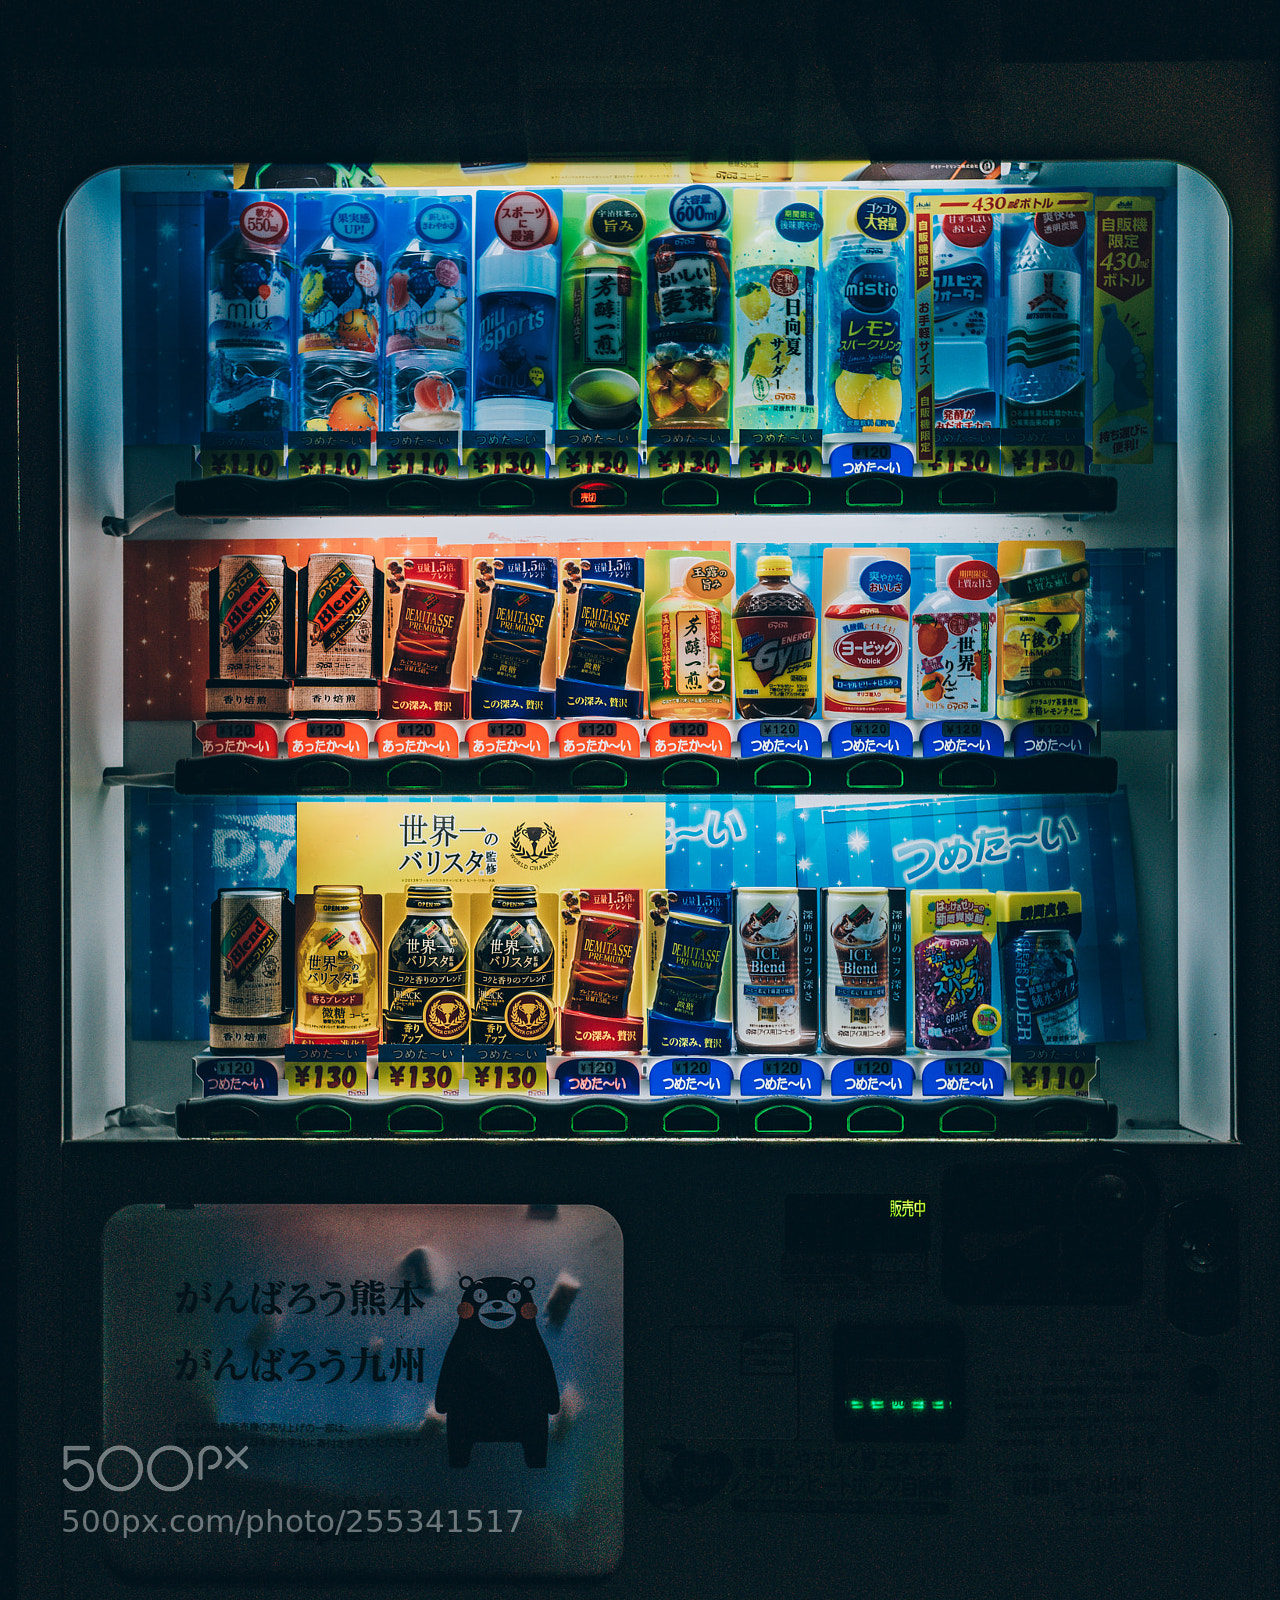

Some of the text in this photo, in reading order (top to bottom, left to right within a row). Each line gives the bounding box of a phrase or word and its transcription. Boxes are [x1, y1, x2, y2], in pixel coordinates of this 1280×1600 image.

[680, 194, 711, 205] 大容量
[501, 206, 545, 219] スポーツ
[597, 209, 638, 218] 宇治抹茶の
[676, 205, 717, 222] 600ml
[865, 203, 898, 214] ゴクゴク
[338, 212, 371, 224] 果実感
[428, 213, 449, 221] 新しい
[518, 219, 528, 228] に
[864, 215, 899, 231] 大容量
[247, 217, 279, 232] 550ml
[344, 223, 366, 235] UP!
[603, 219, 634, 233] 旨み
[952, 225, 987, 233] おいしさ
[1043, 220, 1079, 235] 透明炭酸
[1102, 217, 1149, 232] 自販機
[510, 229, 535, 242] 最適
[674, 237, 696, 246] DyDo
[1108, 234, 1140, 249] 限定
[705, 239, 717, 249] 600
[918, 220, 929, 278] 自販機限定
[659, 267, 710, 288] おいしい
[1103, 273, 1145, 288] ボトル
[845, 281, 899, 297] mistio
[661, 284, 712, 318] 麦茶
[590, 274, 618, 356] 芳醇一煎
[785, 297, 802, 357] 日向夏
[848, 321, 896, 337] レモン
[838, 339, 903, 352] スパークリング
[918, 302, 930, 375] お手軽サイズ
[770, 337, 786, 390] サイダー
[774, 392, 797, 402] DyDo
[942, 409, 976, 421] 発酵が
[919, 396, 931, 454] 自販機限定
[1099, 424, 1149, 443] 持ち運びに
[580, 492, 597, 503] 売切
[430, 572, 453, 580] ブレンド
[522, 571, 546, 579] ブレンド
[691, 565, 728, 579] 玉露の
[868, 571, 903, 582] 爽やかな
[227, 566, 254, 601] DyDo
[318, 566, 346, 600] DyDo
[701, 579, 722, 591] 旨み
[869, 582, 903, 593] おいしさ
[957, 579, 993, 588] 上質な甘さ
[226, 578, 270, 631] Blend
[316, 577, 362, 629] Blend
[405, 607, 455, 629] DEMITASSE
[495, 607, 546, 628] DEMITASSE
[580, 606, 631, 627] DEMITASSE
[408, 621, 444, 635] PREMIUM
[500, 620, 536, 634] PREMIUM
[584, 619, 620, 633] PREMIUM
[767, 621, 789, 630] DyDo
[781, 630, 812, 646] ENERGY
[683, 614, 703, 690] 芳醇一煎
[841, 641, 896, 656] ヨービック
[745, 638, 813, 677] Gym
[857, 657, 881, 665] Yobick
[957, 636, 976, 681] 世界一
[941, 658, 958, 700] りんご
[223, 695, 267, 705] 香り焙煎
[312, 694, 356, 704] 香り焙煎
[391, 700, 452, 712] この深み、贅沢
[482, 699, 544, 710] この深み、贅沢
[567, 696, 628, 708] この深み、贅沢
[946, 701, 970, 711] DyDo
[1027, 705, 1082, 716] 本格レモンティー
[219, 723, 251, 737] ¥120
[309, 723, 343, 737] ¥120
[400, 723, 433, 737] ¥120
[490, 723, 523, 737] ¥120
[581, 723, 614, 737] ¥120
[672, 723, 706, 737] ¥120
[764, 723, 795, 734] ¥120
[854, 723, 887, 734] ¥120
[946, 723, 979, 734] ¥120
[399, 814, 499, 848] 世界一の
[510, 851, 560, 872] WORLD CHAMPION
[608, 903, 632, 911] ブレンド
[935, 899, 986, 913] はじけるゼリーの
[935, 911, 986, 926] 新感覚炭酸
[229, 918, 266, 967] Blend
[406, 939, 455, 955] 世界一の
[490, 939, 539, 955] 世界一の
[584, 938, 633, 958] DEMITASSE
[949, 938, 970, 947] DyDo
[588, 952, 624, 964] PREMIUM
[671, 942, 721, 963] DEMITASSE
[756, 947, 780, 960] ICE
[803, 909, 814, 1002] 深煎りのコク深さ
[849, 949, 873, 961] ICE
[891, 909, 903, 1002] 深煎りのコク深さ
[307, 955, 359, 972] 世界一の
[675, 957, 712, 970] PREMIUM
[751, 960, 786, 974] Blend
[843, 961, 878, 975] Blend
[398, 973, 462, 985] コクと香りのブレンド
[482, 974, 547, 985] コクと香りのブレンド
[312, 995, 356, 1004] 香るブレンド
[395, 990, 421, 1000] BLACK
[480, 990, 503, 1000] BLACK
[322, 1007, 346, 1019] 微糖
[1014, 976, 1032, 1041] CIDER
[945, 1010, 968, 1024] GRAPE
[403, 1023, 420, 1033] 香り
[486, 1023, 503, 1034] 香り
[223, 1032, 267, 1042] 香り焙煎
[401, 1033, 424, 1044] アップ
[484, 1034, 507, 1045] アップ
[574, 1030, 637, 1042] この深み、贅沢
[661, 1037, 722, 1048] この深み、贅沢
[219, 1061, 252, 1074] ¥120
[581, 1061, 614, 1074] ¥120
[675, 1061, 708, 1074] ¥120
[766, 1061, 799, 1074] ¥120
[856, 1061, 890, 1074] ¥120
[948, 1062, 980, 1074] ¥120
[294, 1065, 357, 1089] ¥130
[389, 1065, 452, 1089] ¥130
[474, 1065, 537, 1089] ¥130
[1021, 1065, 1086, 1090] ¥110
[890, 1199, 926, 1218] 販売中
[175, 1278, 425, 1317] がんばろう熊本
[175, 1346, 425, 1384] がんばろう九州
